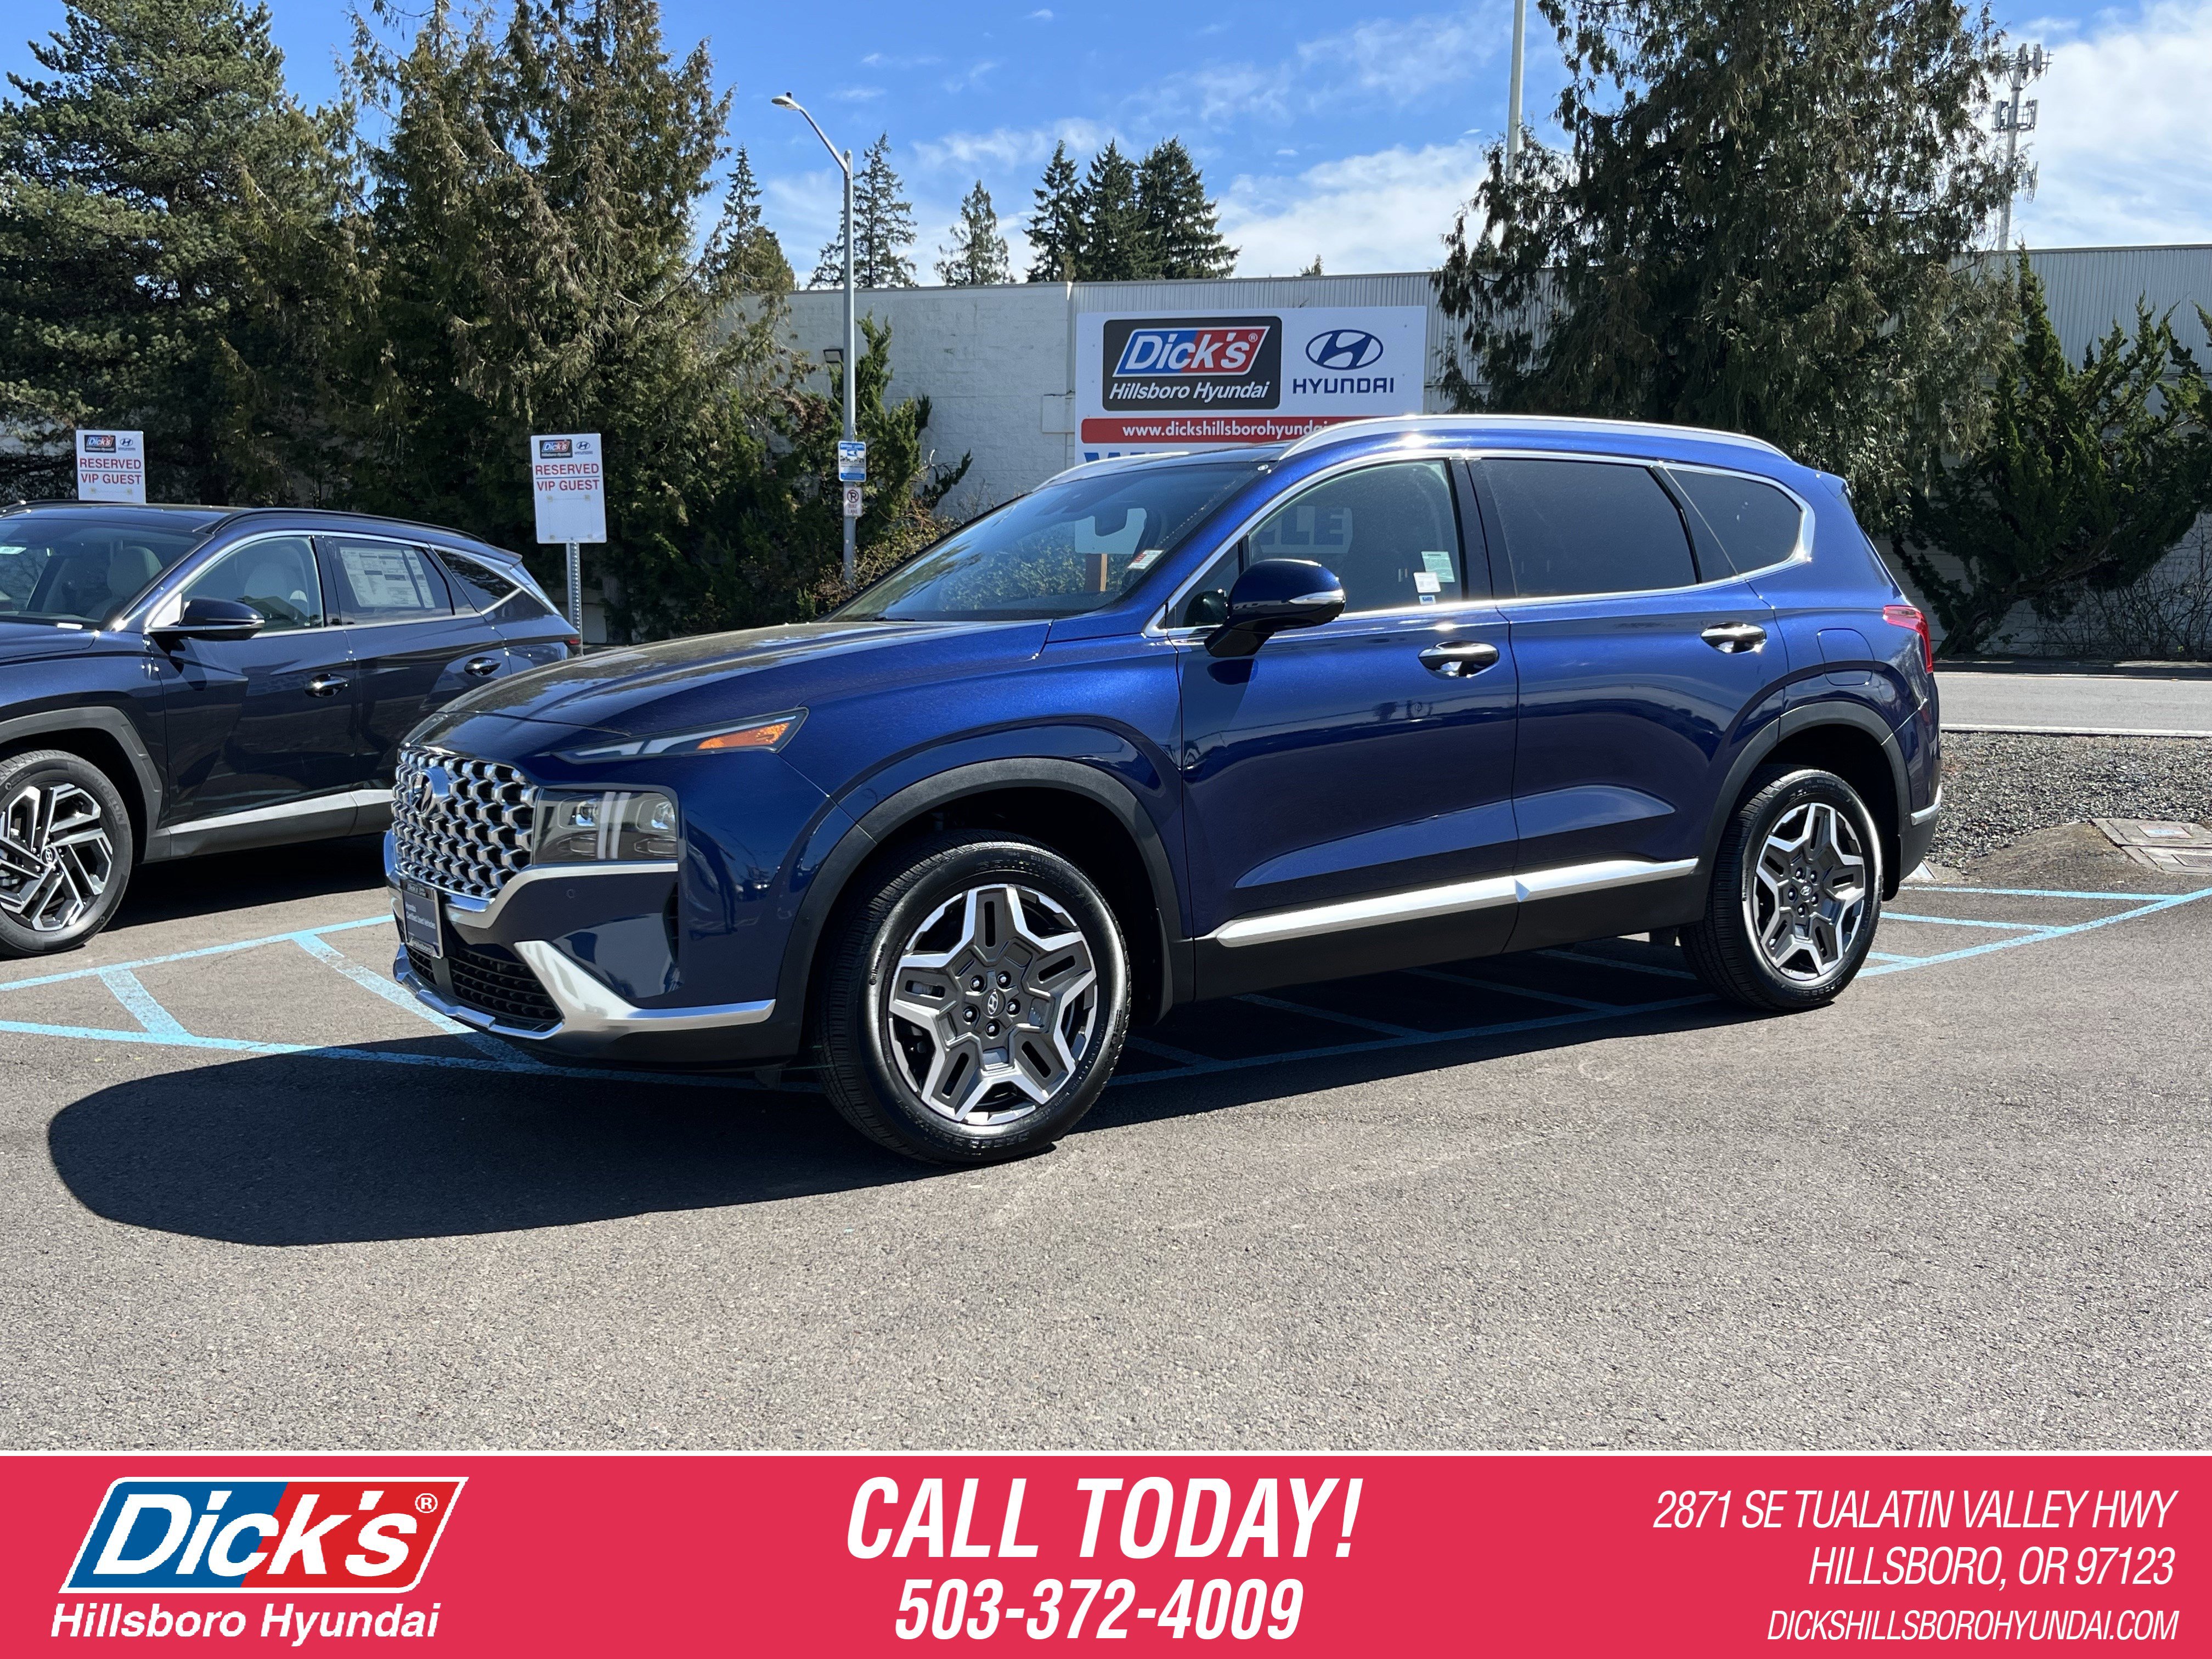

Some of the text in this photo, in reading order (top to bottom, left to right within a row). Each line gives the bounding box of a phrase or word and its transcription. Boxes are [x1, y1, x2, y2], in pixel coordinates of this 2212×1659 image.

[1125, 332, 1250, 370] Dick's
[1293, 377, 1395, 394] HYUNDAI
[1109, 381, 1271, 404] Hillsboro Hyundai
[80, 458, 142, 470] RESERVED
[535, 463, 600, 476] RESERVED
[81, 473, 142, 485] VIP GUEST
[537, 479, 600, 492] VIP GUEST
